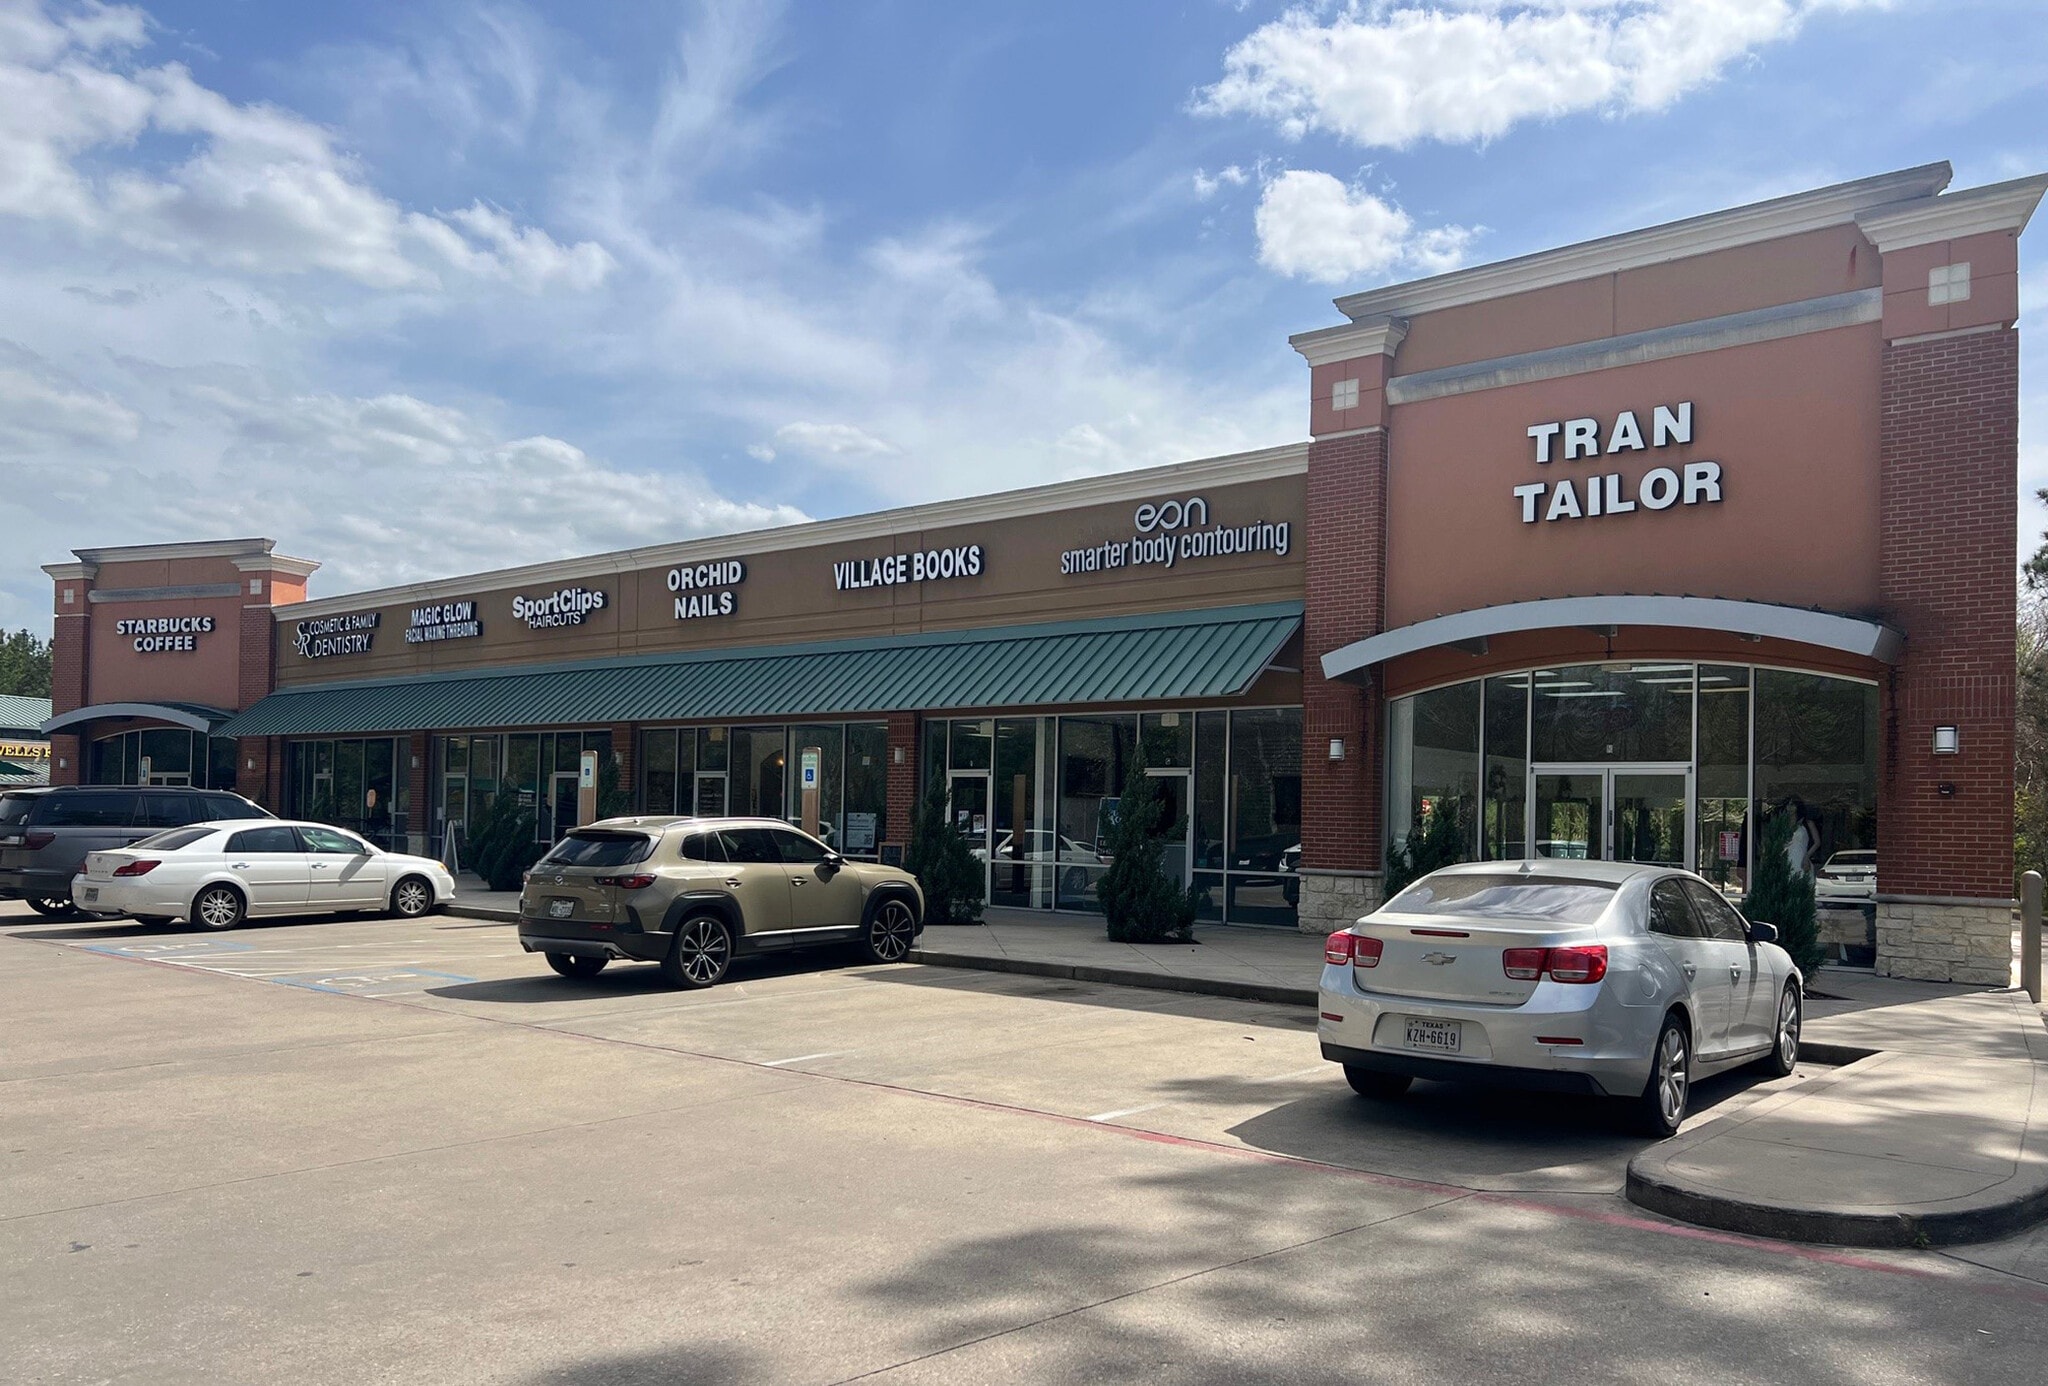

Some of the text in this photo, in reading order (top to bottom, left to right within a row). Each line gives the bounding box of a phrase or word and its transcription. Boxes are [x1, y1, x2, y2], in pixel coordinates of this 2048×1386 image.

[1527, 401, 1692, 463] TRAN
[1513, 461, 1721, 523] TAILOR
[1134, 497, 1207, 532] eon
[1060, 520, 1289, 574] smarter body contouring
[667, 560, 743, 591] ORCHID
[833, 545, 981, 590] VILLAGE BOOKS
[411, 601, 472, 626] MAGIC GLOW
[512, 588, 604, 621] SportClips
[674, 592, 733, 619] NAILS
[116, 617, 212, 635] STARBUCKS
[309, 613, 377, 636] COSMETIC & FAMILY
[405, 620, 478, 643] FACIAL WAXING THREADING
[528, 611, 581, 629] HAIRCUTS
[133, 635, 193, 652] COFFEE
[315, 633, 370, 657] DENTISTRY
[1422, 1021, 1444, 1029] TEXAS
